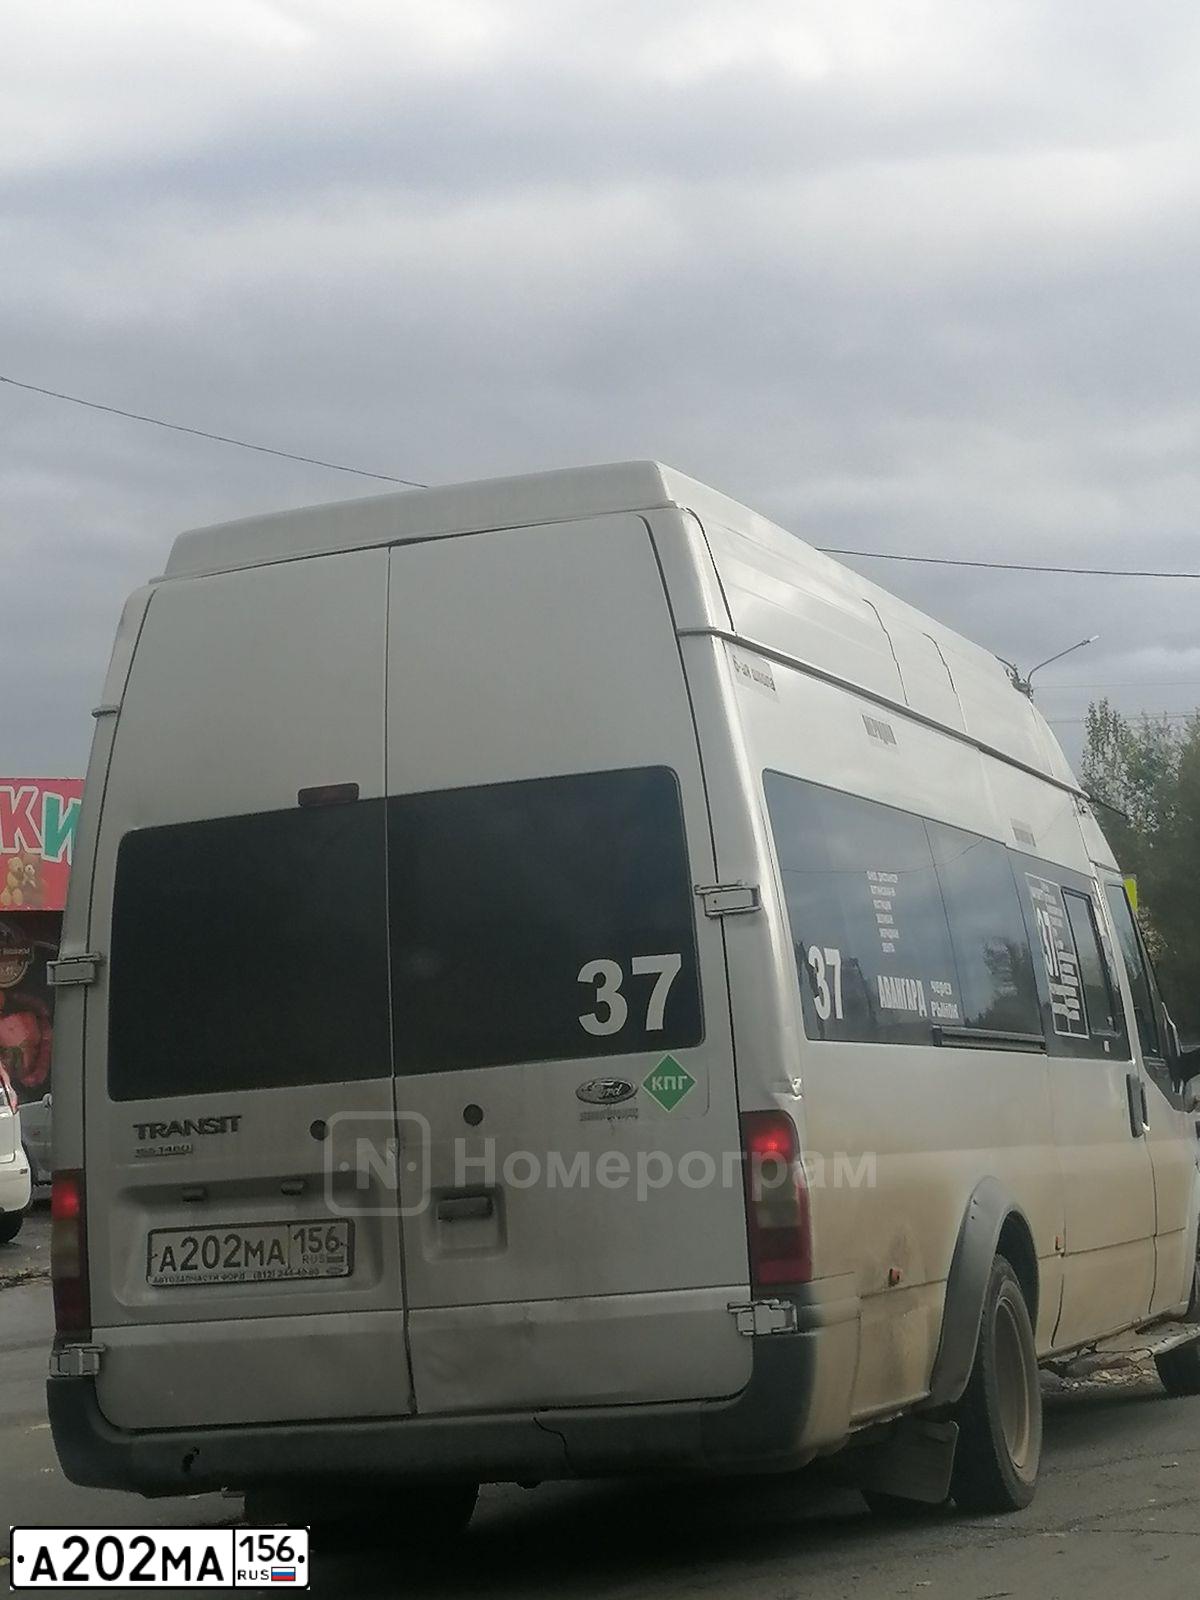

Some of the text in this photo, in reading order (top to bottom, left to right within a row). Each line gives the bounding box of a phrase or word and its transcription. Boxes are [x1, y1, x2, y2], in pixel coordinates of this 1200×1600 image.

[577, 953, 682, 1036] 37
[808, 945, 843, 1021] 37
[652, 1075, 688, 1091] КПГ
[132, 1115, 242, 1140] TRANSIT
[159, 1226, 341, 1272] А202МА 156
[302, 1253, 326, 1265] RUS
